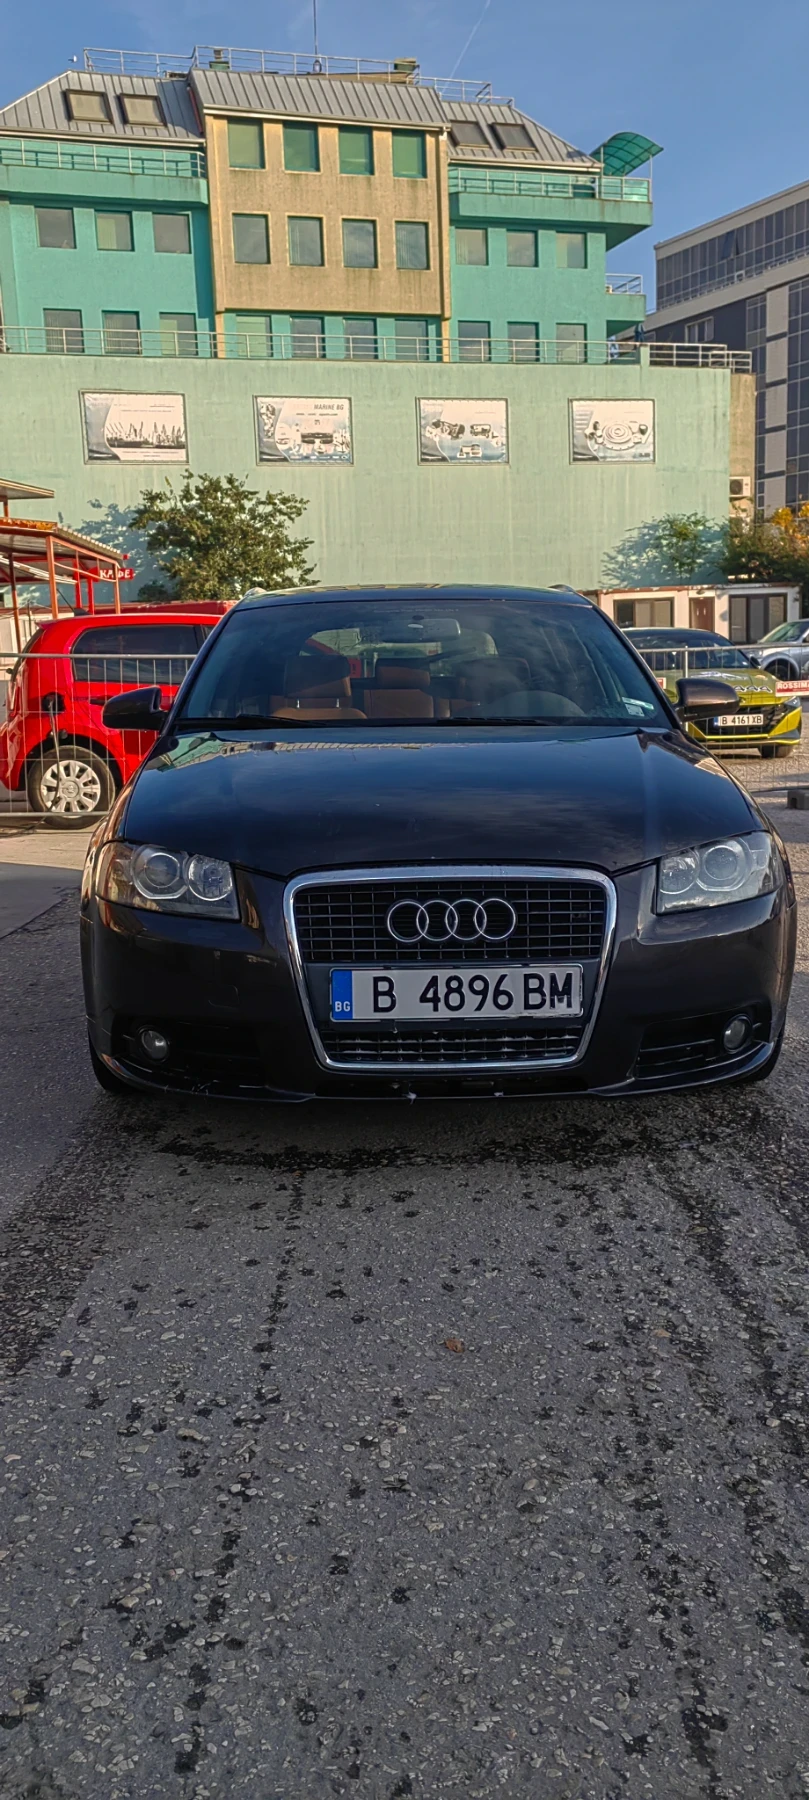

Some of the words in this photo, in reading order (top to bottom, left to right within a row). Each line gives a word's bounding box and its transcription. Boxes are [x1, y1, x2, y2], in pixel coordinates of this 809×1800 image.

[313, 403, 335, 411] MARINE
[777, 681, 809, 690] ROSSIM
[722, 716, 728, 725] B
[731, 715, 750, 725] 4161
[751, 714, 762, 724] XB
[372, 975, 397, 1014] B
[419, 973, 515, 1013] 4896
[523, 972, 573, 1011] BM
[334, 1001, 351, 1012] BG
